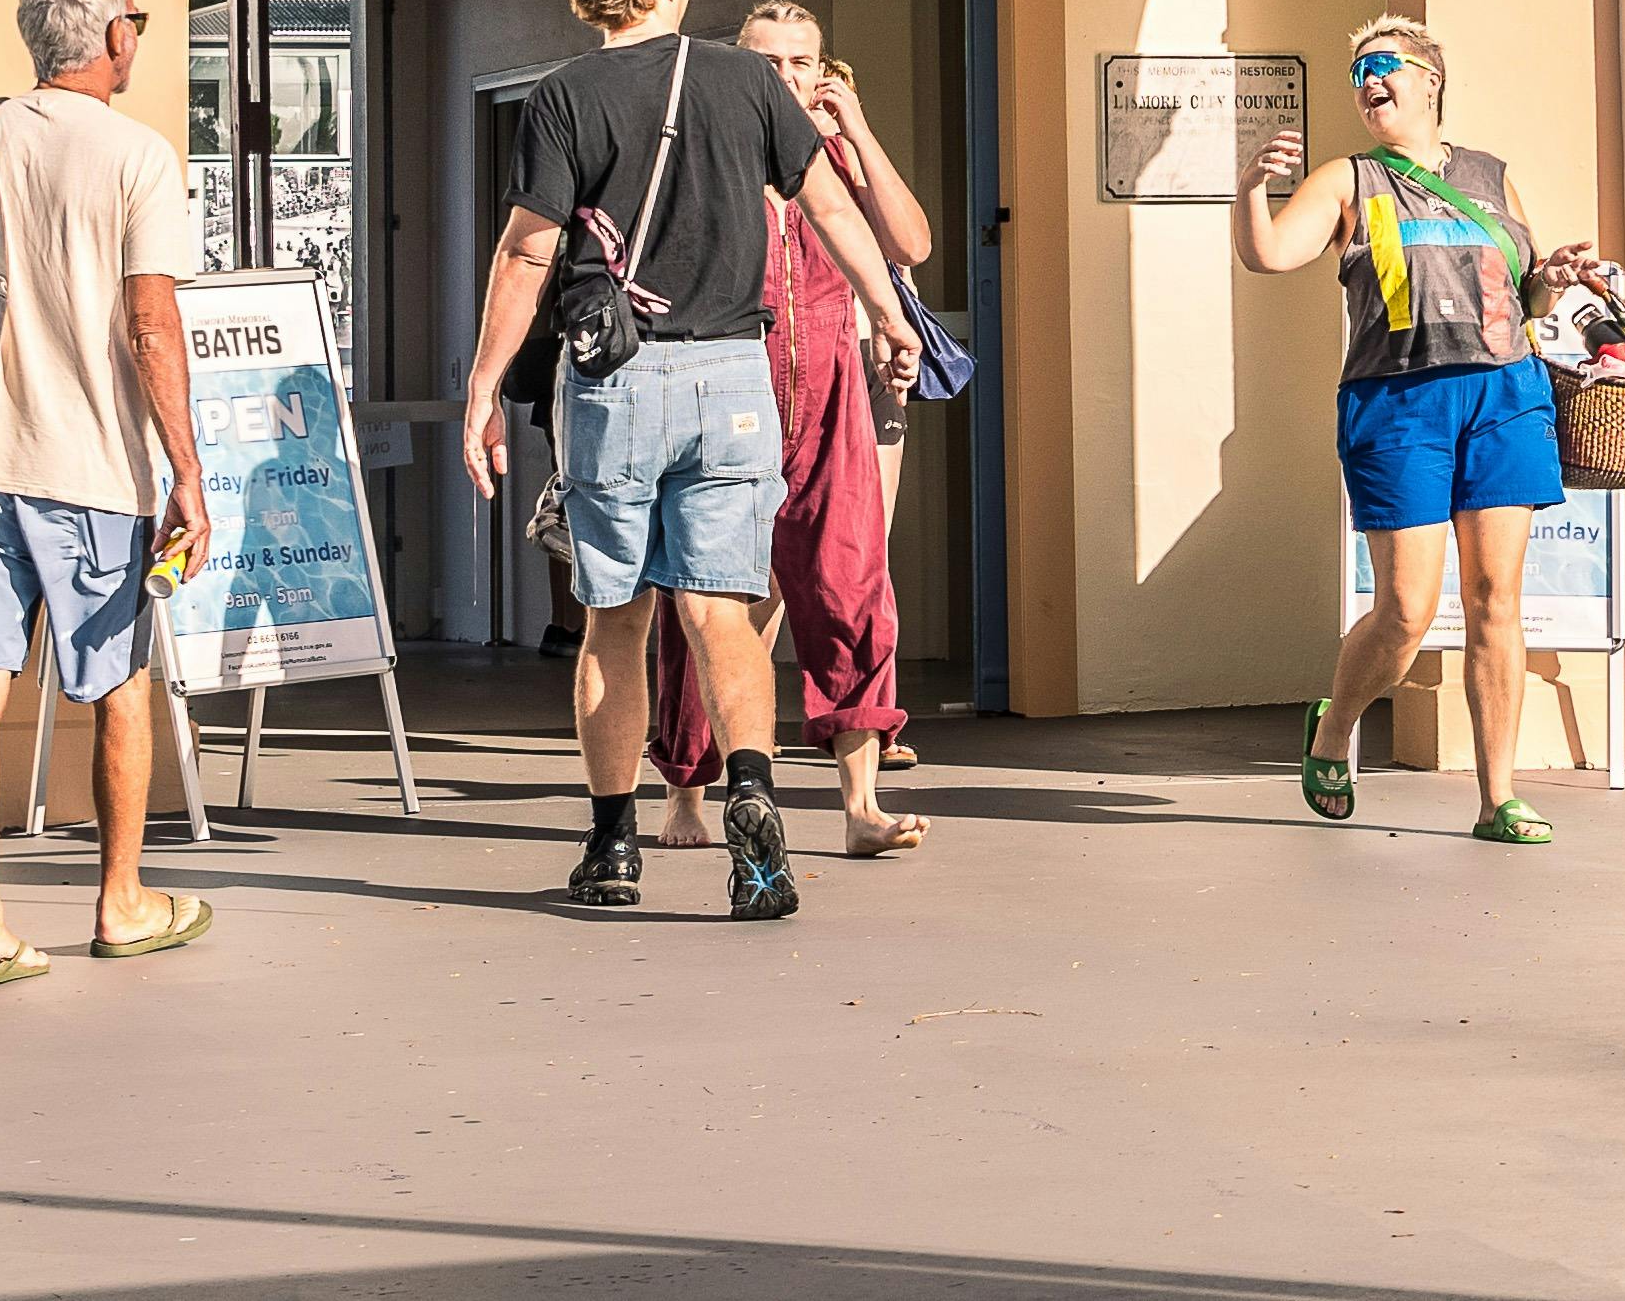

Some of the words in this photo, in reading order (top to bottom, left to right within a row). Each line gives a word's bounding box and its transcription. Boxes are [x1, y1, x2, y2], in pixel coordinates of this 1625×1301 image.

[1240, 66, 1296, 77] RESTORED
[1113, 94, 1182, 110] LISMORE
[1235, 94, 1299, 110] COUNCIL
[191, 325, 283, 359] BATHS
[264, 465, 330, 487] Friday
[259, 509, 298, 531] 7pm
[1529, 521, 1600, 544] unday
[262, 547, 276, 567] &
[280, 541, 352, 565] Sunday
[224, 591, 261, 609] 9am
[277, 586, 313, 606] 5pm
